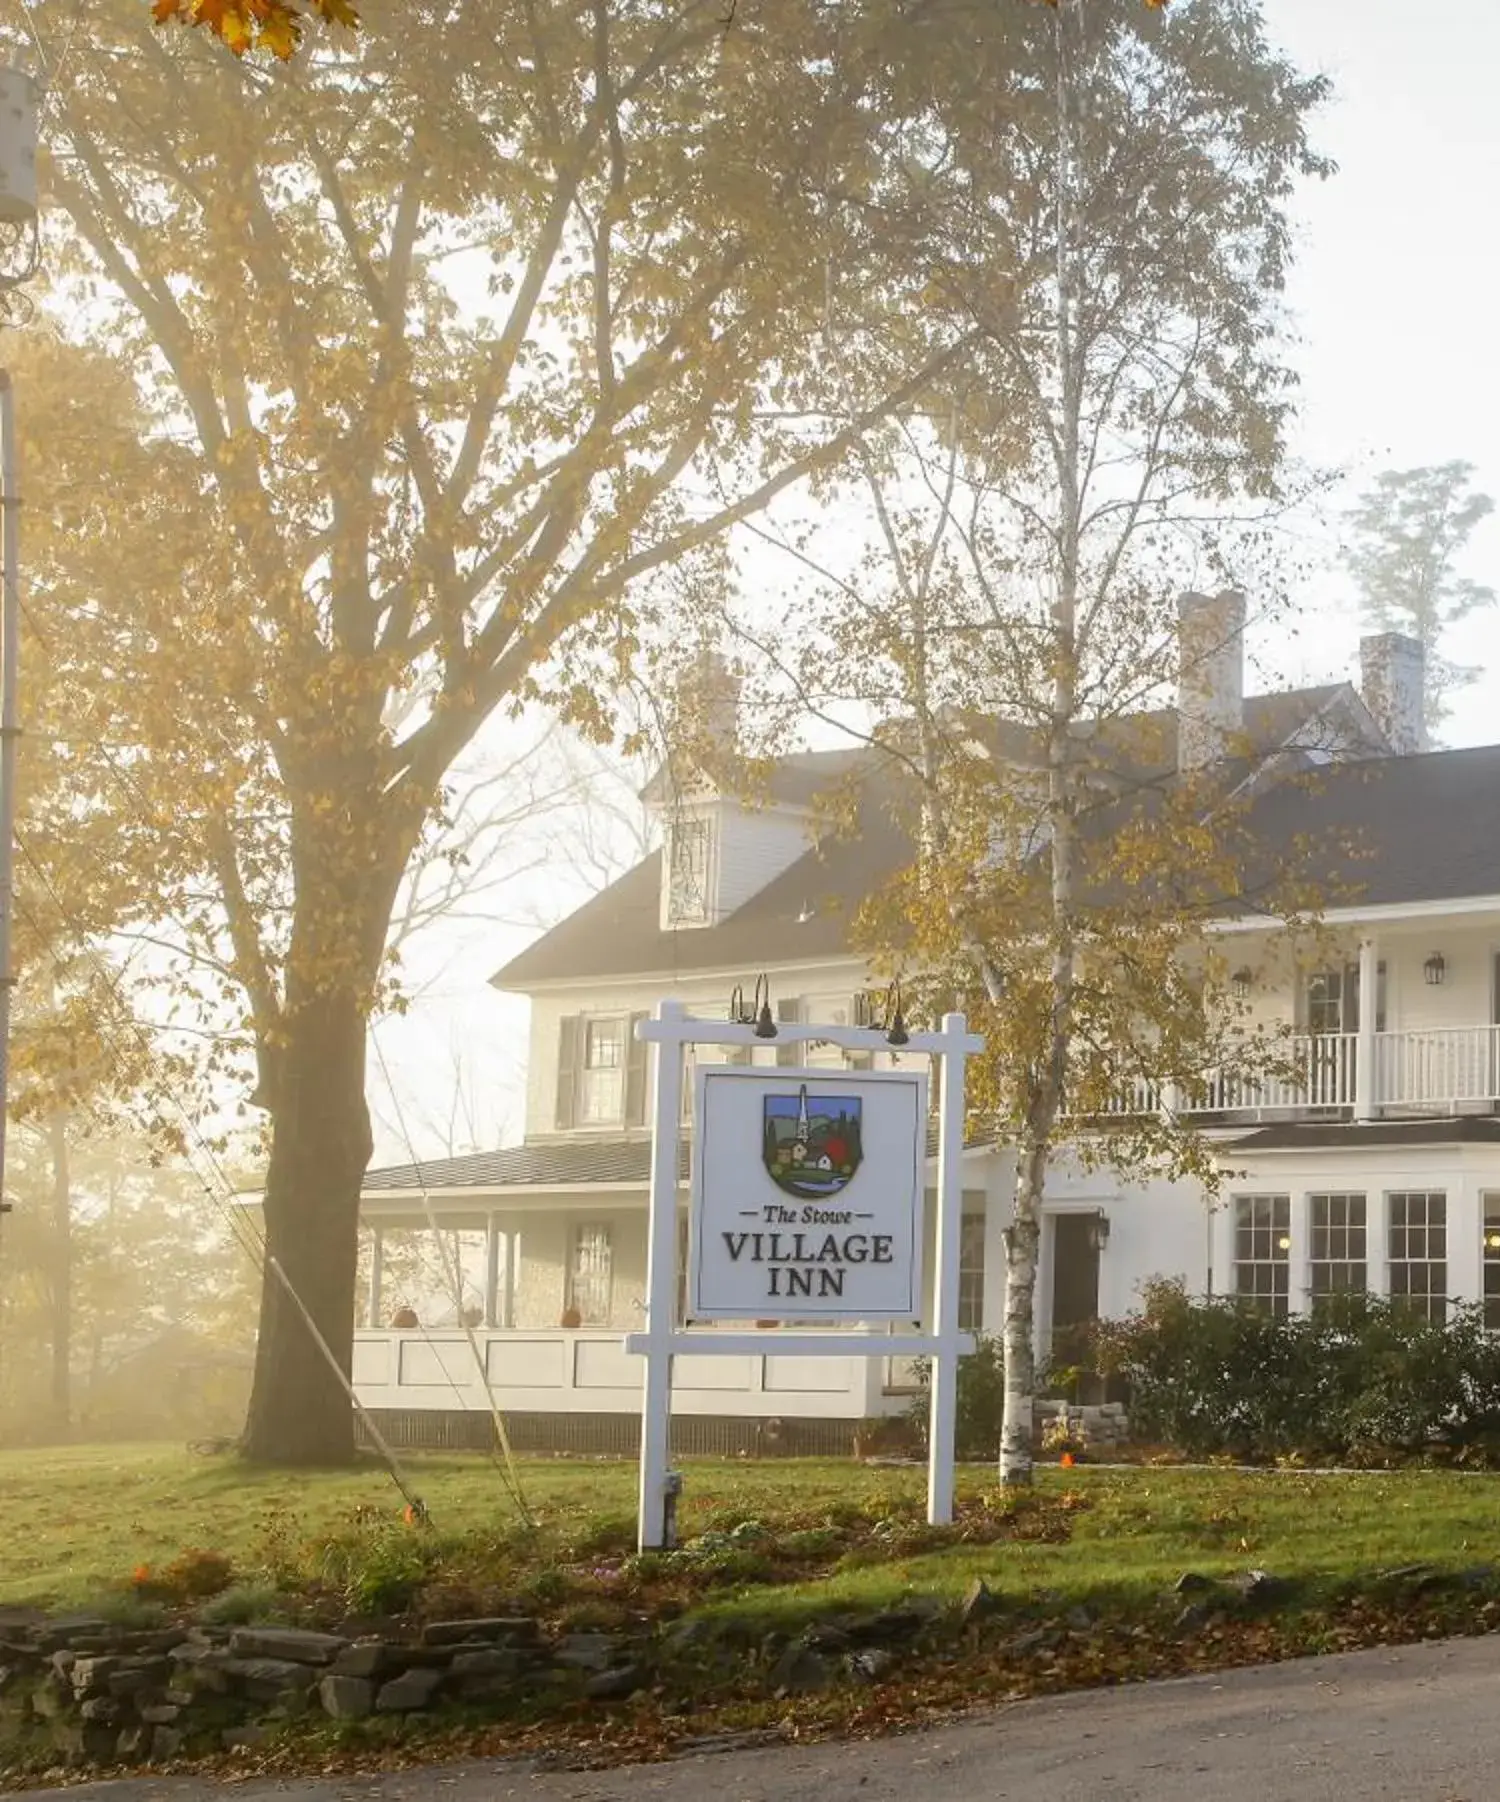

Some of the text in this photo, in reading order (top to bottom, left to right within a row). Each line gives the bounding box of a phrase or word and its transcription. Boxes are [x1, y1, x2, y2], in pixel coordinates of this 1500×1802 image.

[763, 1205, 852, 1225] The Stowe
[721, 1231, 894, 1264] VILLAGE
[767, 1267, 847, 1297] INN
